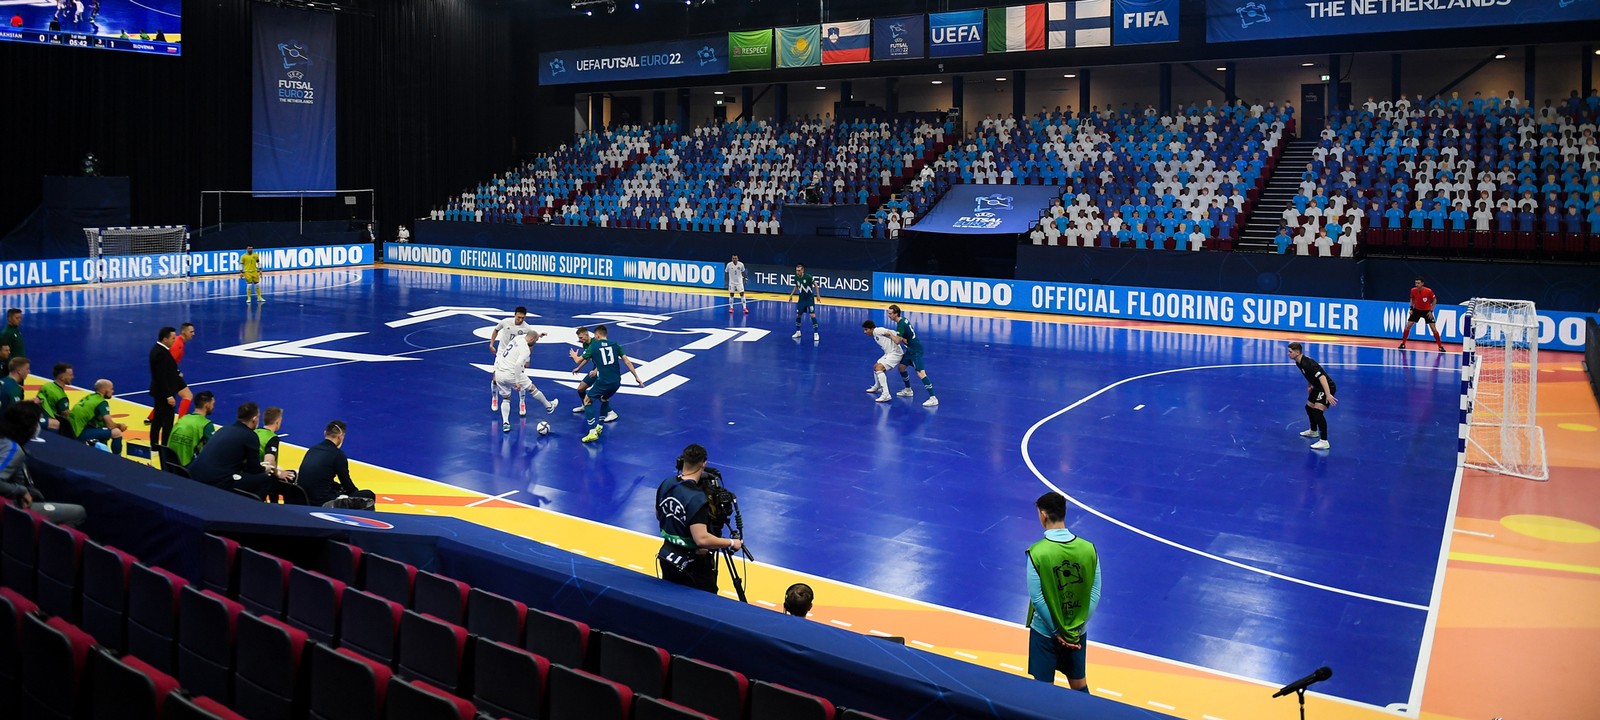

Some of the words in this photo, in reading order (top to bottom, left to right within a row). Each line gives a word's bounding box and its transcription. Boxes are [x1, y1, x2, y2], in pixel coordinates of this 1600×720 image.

[1123, 10, 1169, 29] FIFA
[1305, 1, 1345, 18] THE
[932, 25, 980, 44] UEFA
[741, 46, 768, 55] RESPECT
[576, 59, 600, 71] UEFA
[600, 56, 640, 70] FUTSAL
[278, 79, 314, 90] FUTSAL
[59, 256, 153, 283] FLOORING
[158, 251, 241, 276] SUPPLIER
[273, 245, 363, 269] MONDO
[398, 245, 452, 265] MONDO
[460, 249, 503, 269] OFFICIAL
[506, 252, 556, 273] FLOORING
[559, 255, 613, 277] SUPPLIER
[637, 260, 715, 284] MONDO
[754, 272, 778, 285] THE
[781, 273, 869, 292] NEERLANDS
[904, 277, 1012, 306] MONDO
[1031, 285, 1120, 314] OFFICIAL
[1127, 290, 1234, 322] FLOORING
[1242, 297, 1359, 331] SUPPLIER
[598, 346, 615, 366] 13
